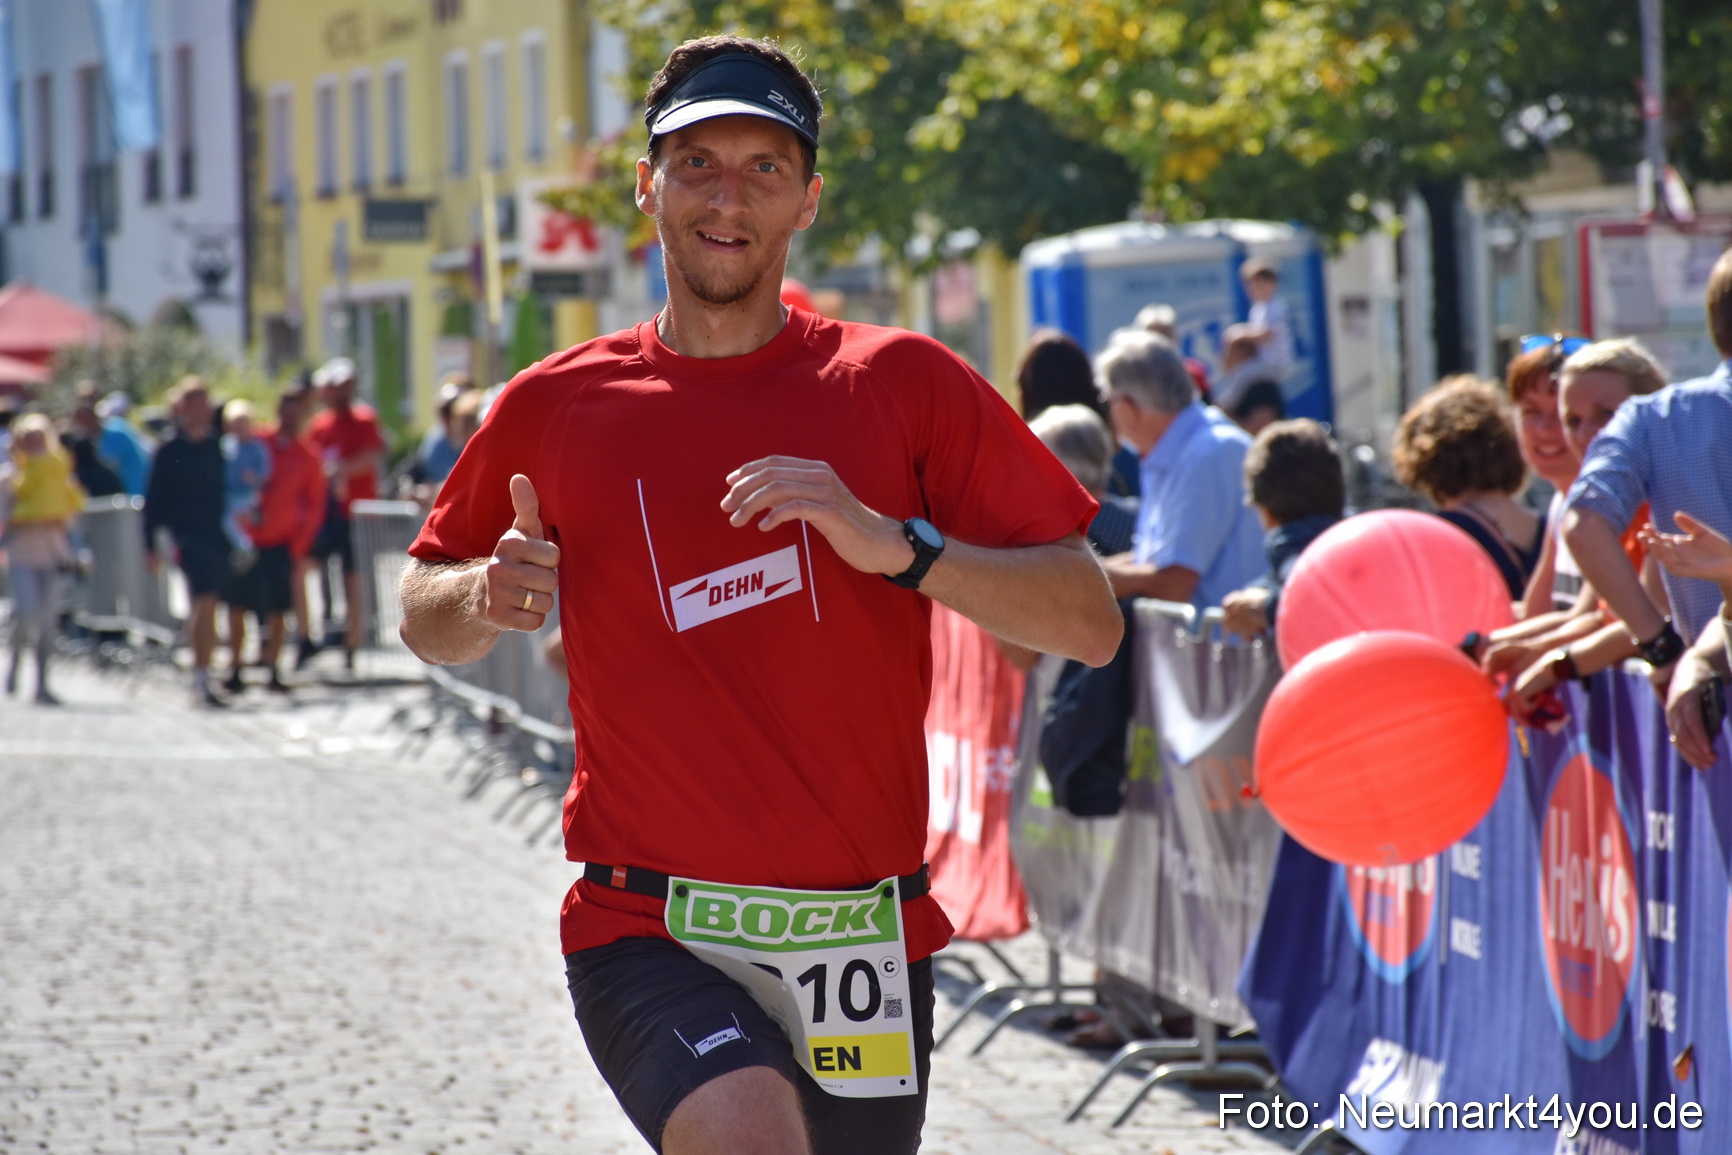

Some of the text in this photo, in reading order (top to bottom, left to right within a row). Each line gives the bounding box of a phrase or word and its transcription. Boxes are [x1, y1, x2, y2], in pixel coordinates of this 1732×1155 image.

[767, 89, 805, 124] 2XU
[708, 569, 764, 607] DEHN
[687, 892, 880, 942] BOCK
[748, 958, 895, 1024] 10 C
[708, 1033, 728, 1046] DEHN
